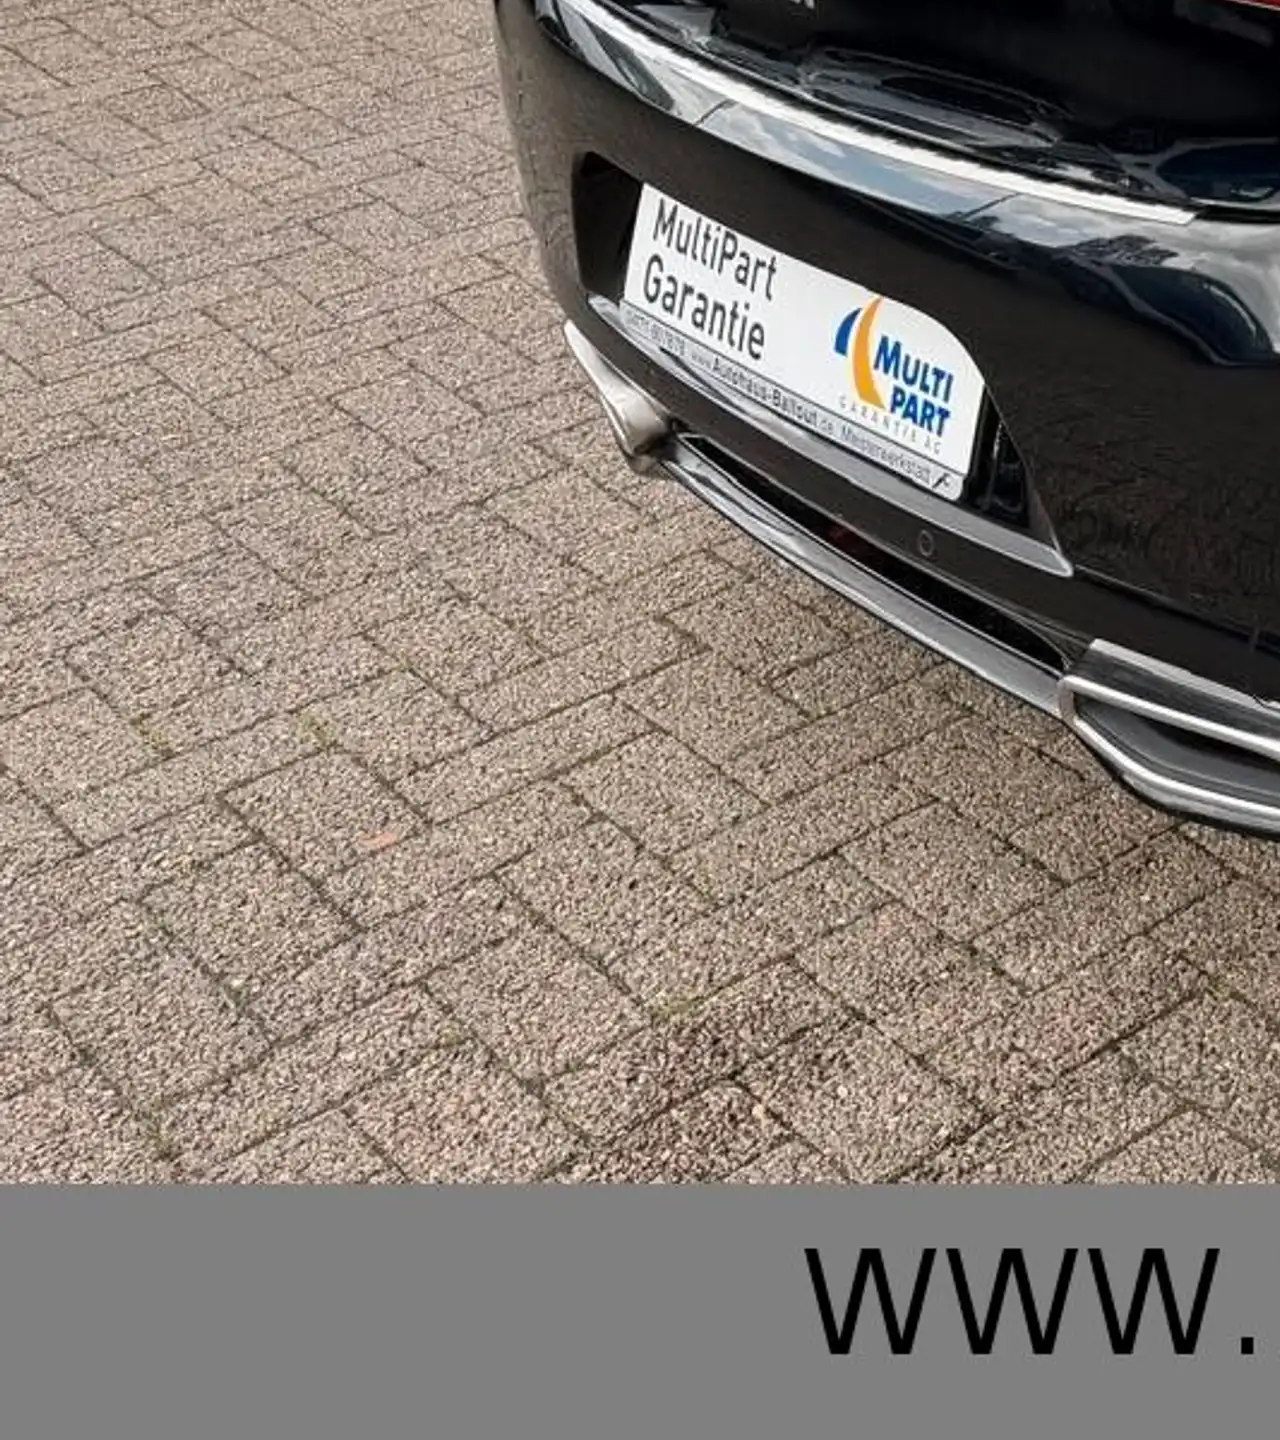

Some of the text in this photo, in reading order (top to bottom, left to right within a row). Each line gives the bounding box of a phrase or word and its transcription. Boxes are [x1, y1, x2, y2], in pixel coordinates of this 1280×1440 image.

[653, 197, 777, 300] MultiPart
[643, 253, 766, 360] Garantie
[873, 335, 954, 403] MULTI
[890, 384, 951, 437] PART
